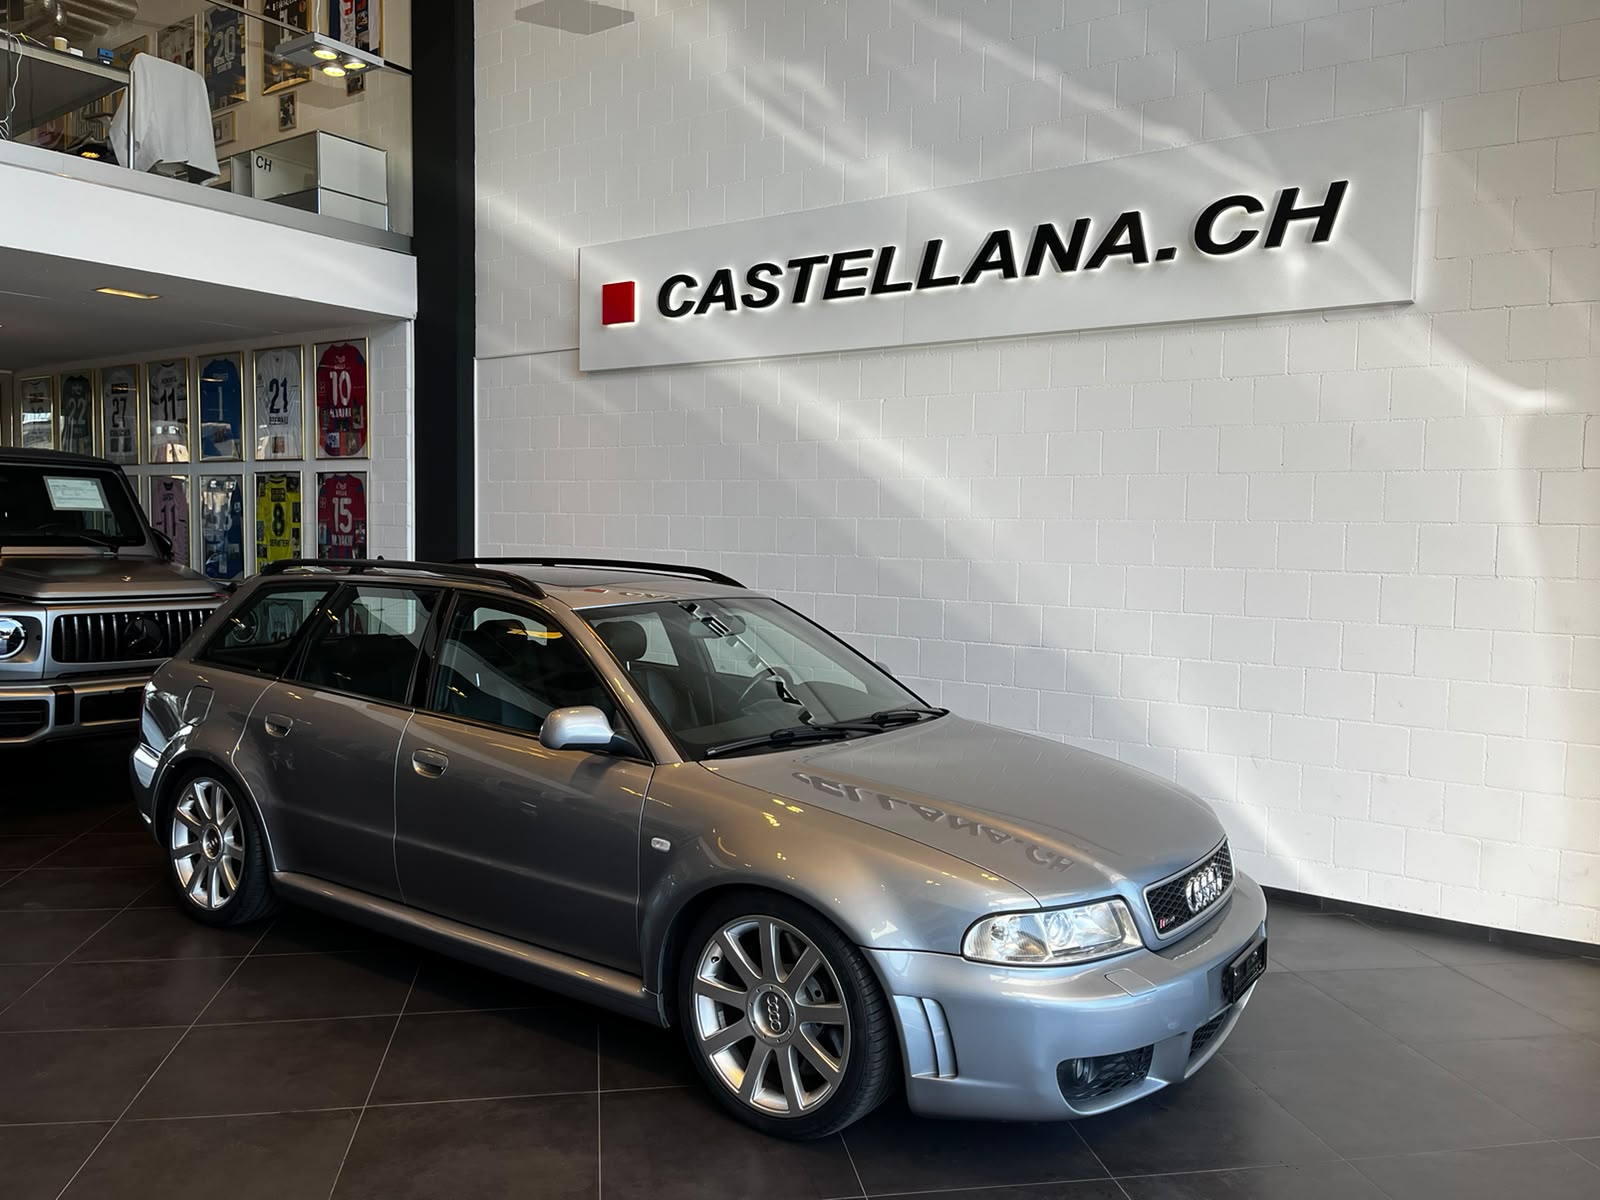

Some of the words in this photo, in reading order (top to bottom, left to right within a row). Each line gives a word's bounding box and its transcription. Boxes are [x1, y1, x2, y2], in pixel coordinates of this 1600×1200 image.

[213, 26, 236, 67] 20
[255, 155, 272, 173] CH
[657, 180, 1348, 319] CASTELLANA.CH
[160, 387, 176, 421] 11
[269, 377, 288, 414] 21
[329, 370, 352, 406] 10
[67, 397, 86, 425] 22
[112, 397, 128, 428] 27
[161, 504, 176, 537] 11
[272, 502, 285, 537] 8
[332, 497, 353, 534] 15
